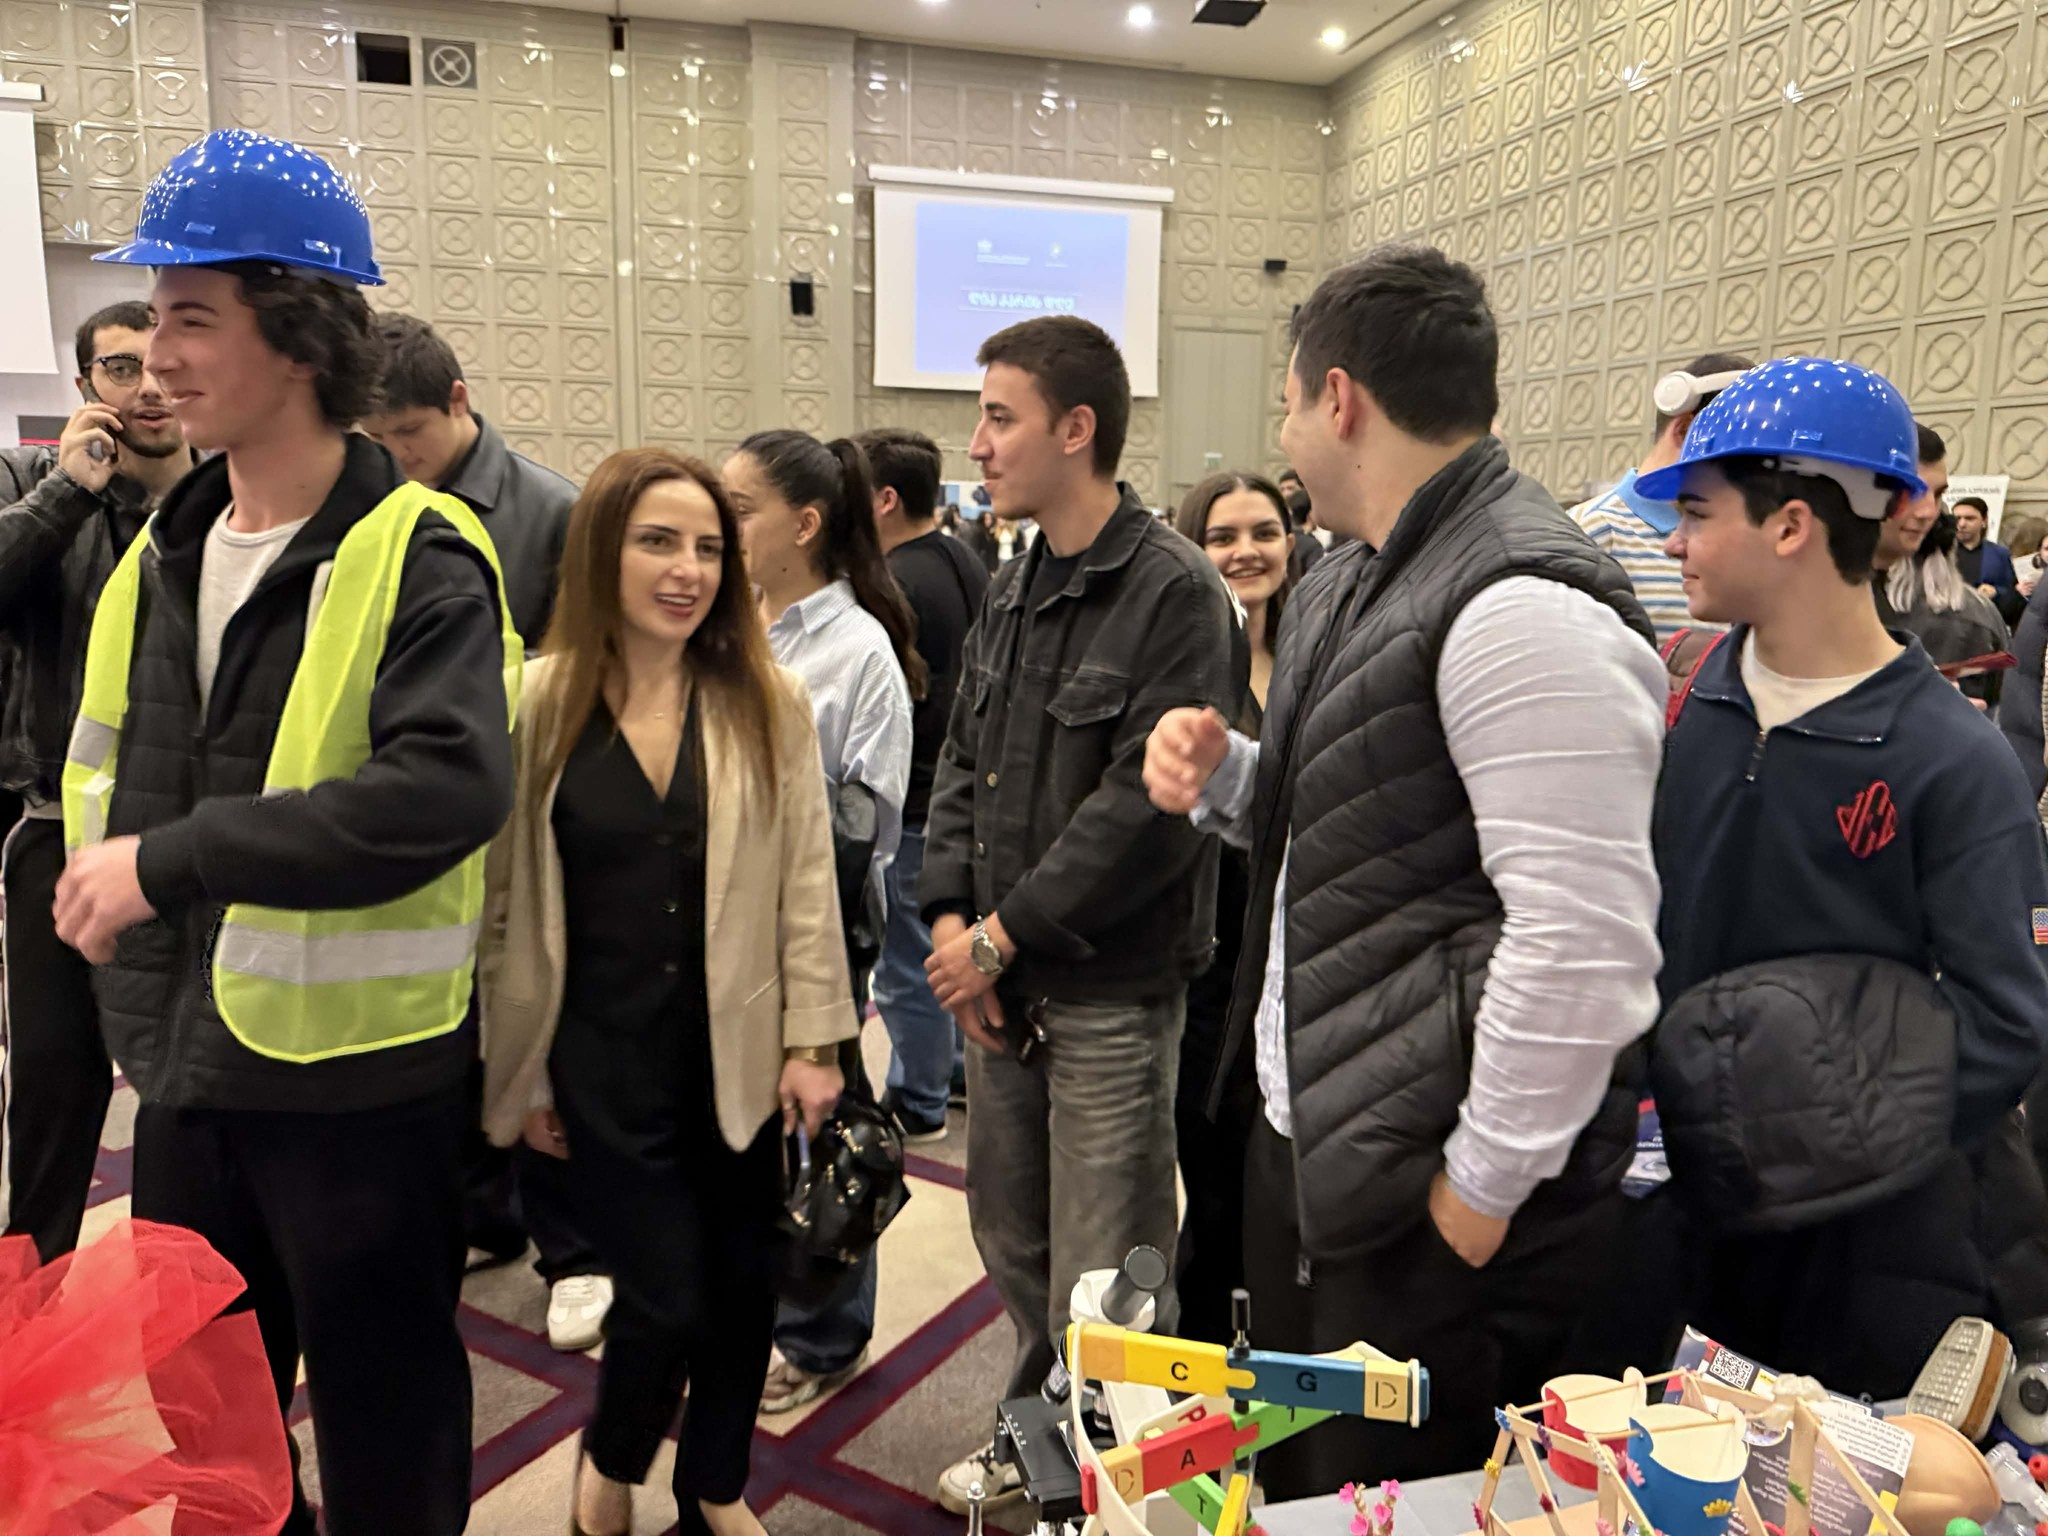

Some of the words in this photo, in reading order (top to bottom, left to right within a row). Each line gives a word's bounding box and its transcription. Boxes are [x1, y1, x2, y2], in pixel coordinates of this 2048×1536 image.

[1171, 1362, 1189, 1381] C
[1296, 1371, 1318, 1392] G
[1375, 1381, 1398, 1409] D
[1181, 1448, 1196, 1470] A
[1197, 1492, 1208, 1515] T
